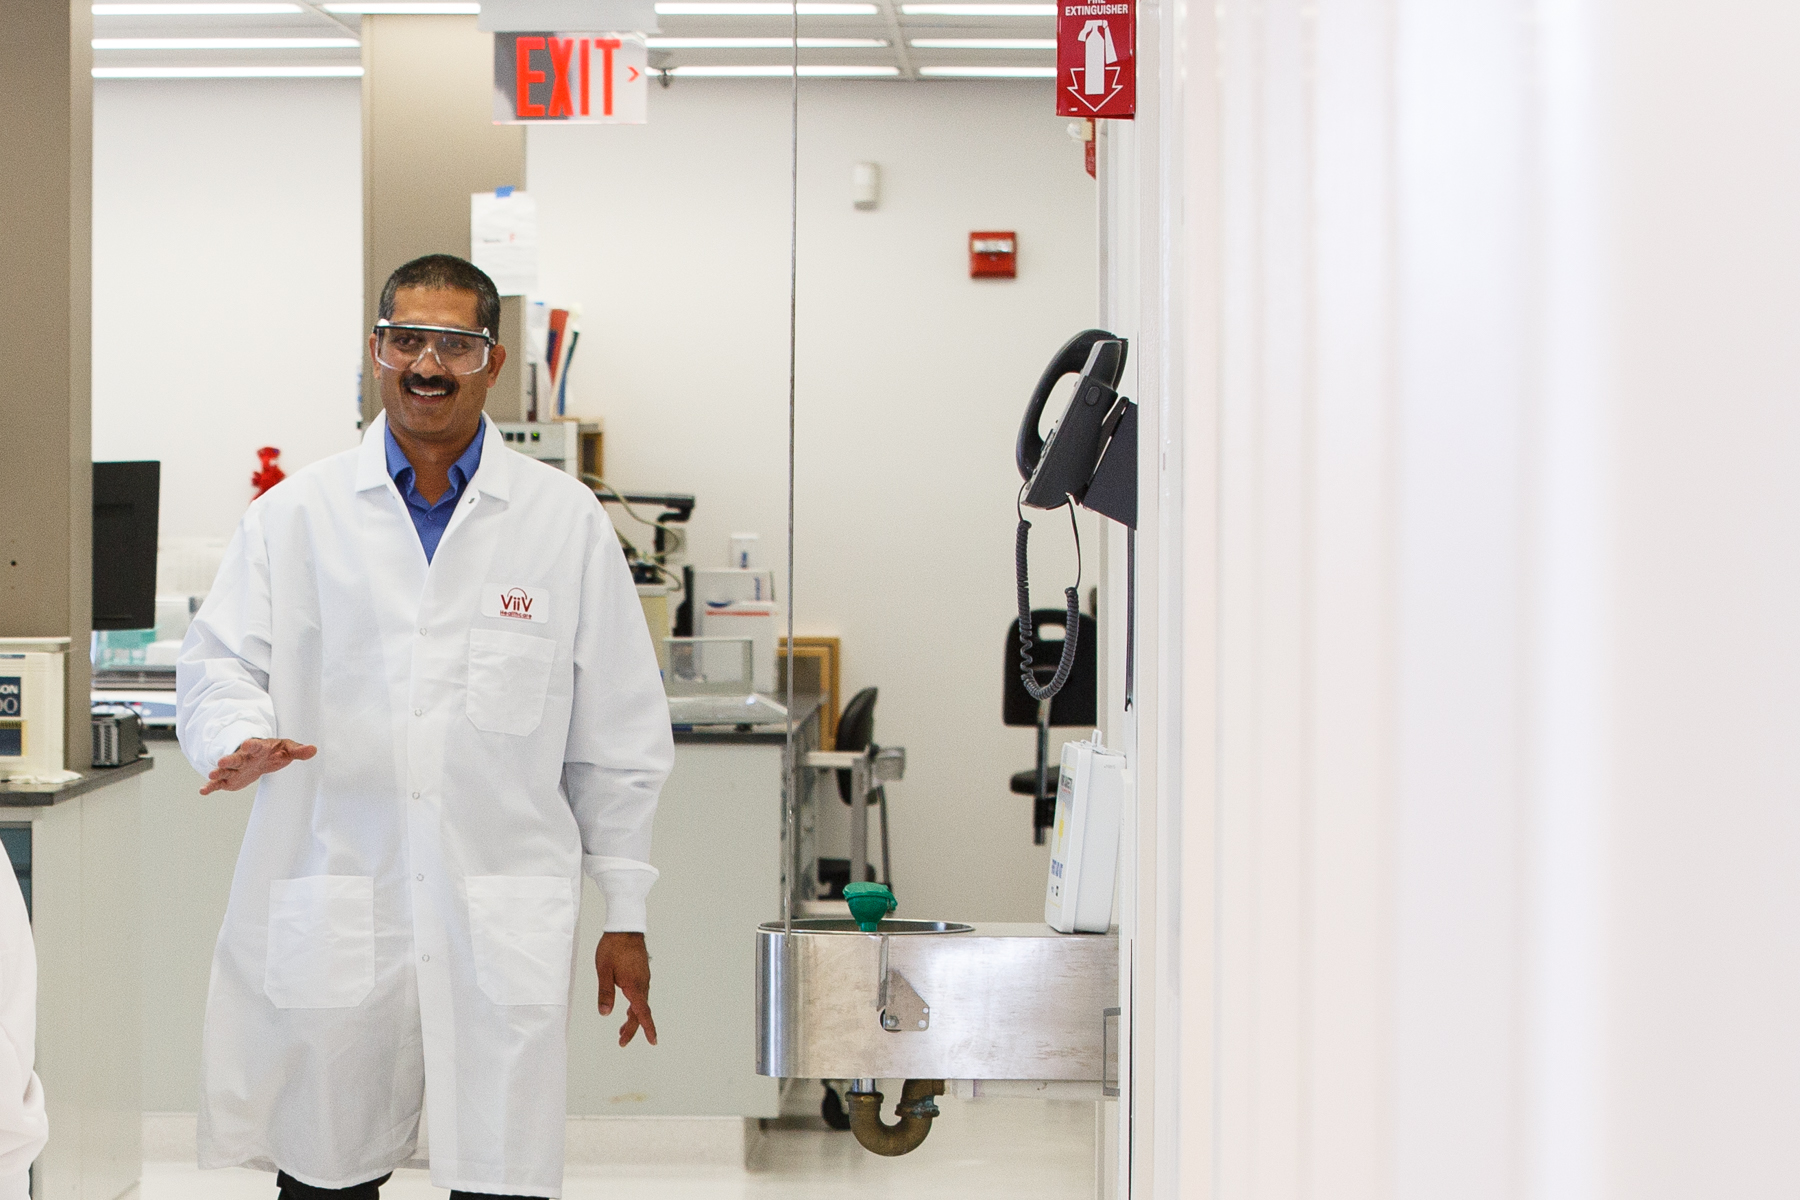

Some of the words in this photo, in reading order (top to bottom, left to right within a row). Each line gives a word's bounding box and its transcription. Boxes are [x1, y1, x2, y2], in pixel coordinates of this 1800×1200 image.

[1065, 4, 1129, 16] EXTINGUISHER
[516, 36, 622, 117] EXIT
[501, 593, 533, 613] ViiV
